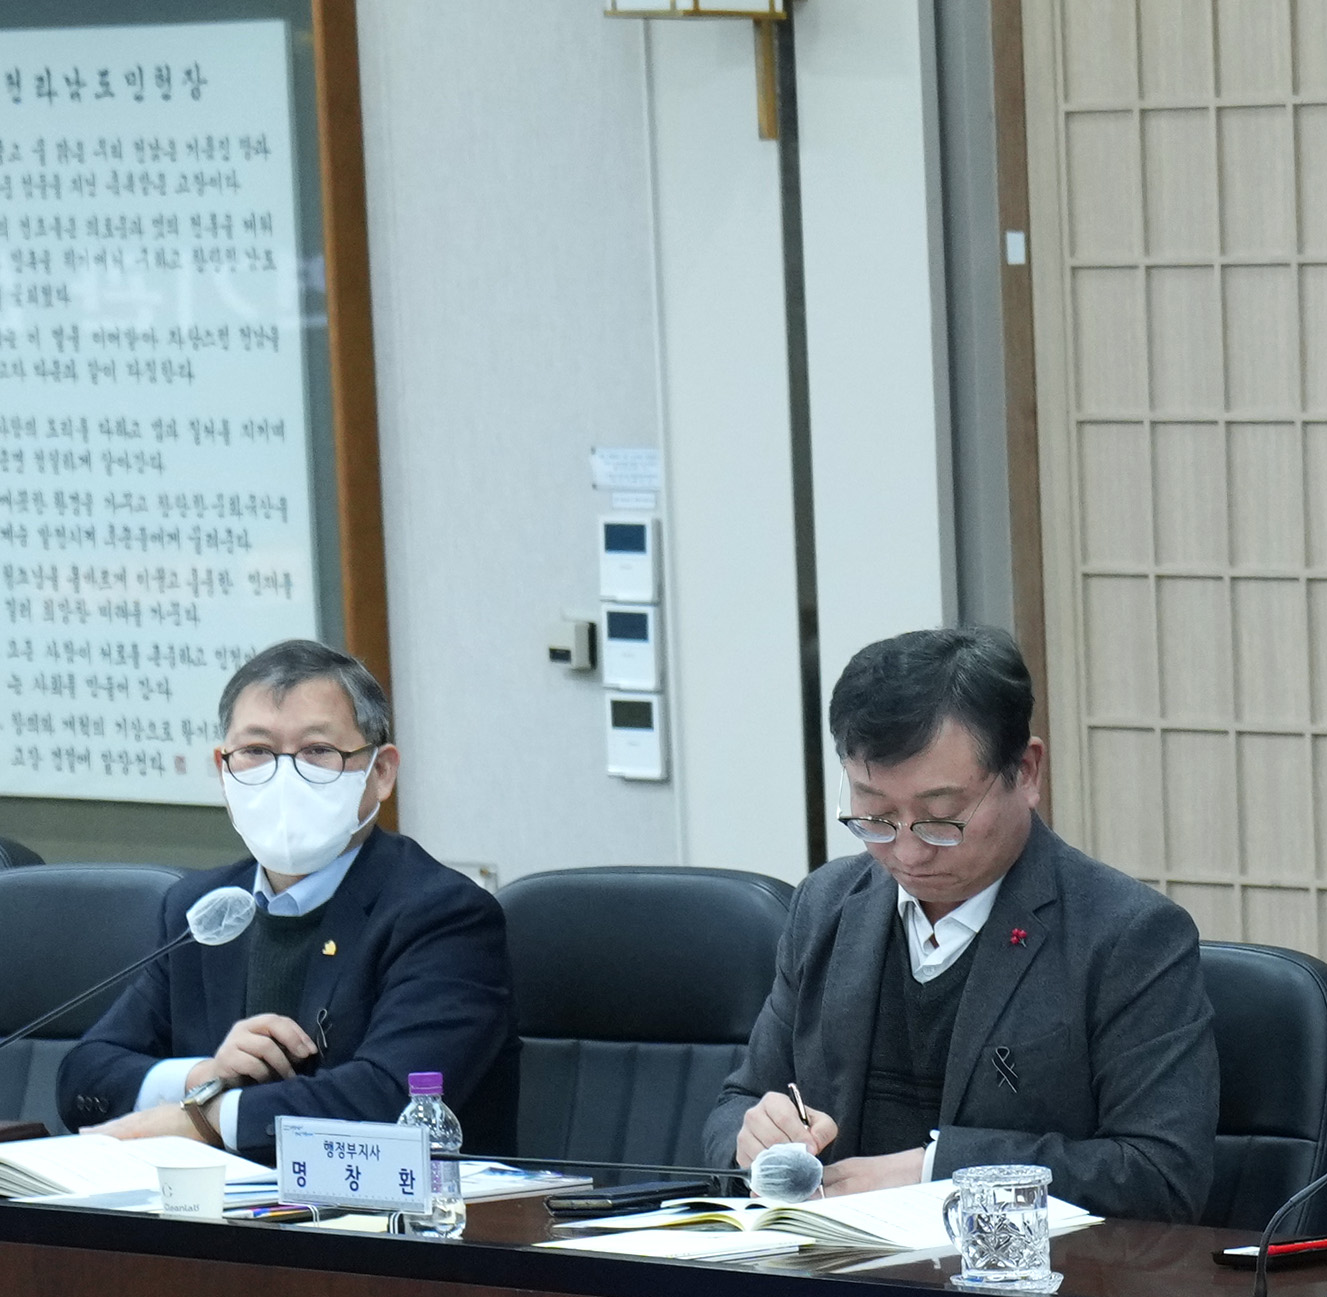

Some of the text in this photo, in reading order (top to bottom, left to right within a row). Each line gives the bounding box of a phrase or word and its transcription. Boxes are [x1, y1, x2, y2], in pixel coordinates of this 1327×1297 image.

[324, 1140, 381, 1161] 행정부지사
[292, 1161, 307, 1188] 명
[345, 1165, 361, 1192] 창
[399, 1168, 415, 1195] 환
